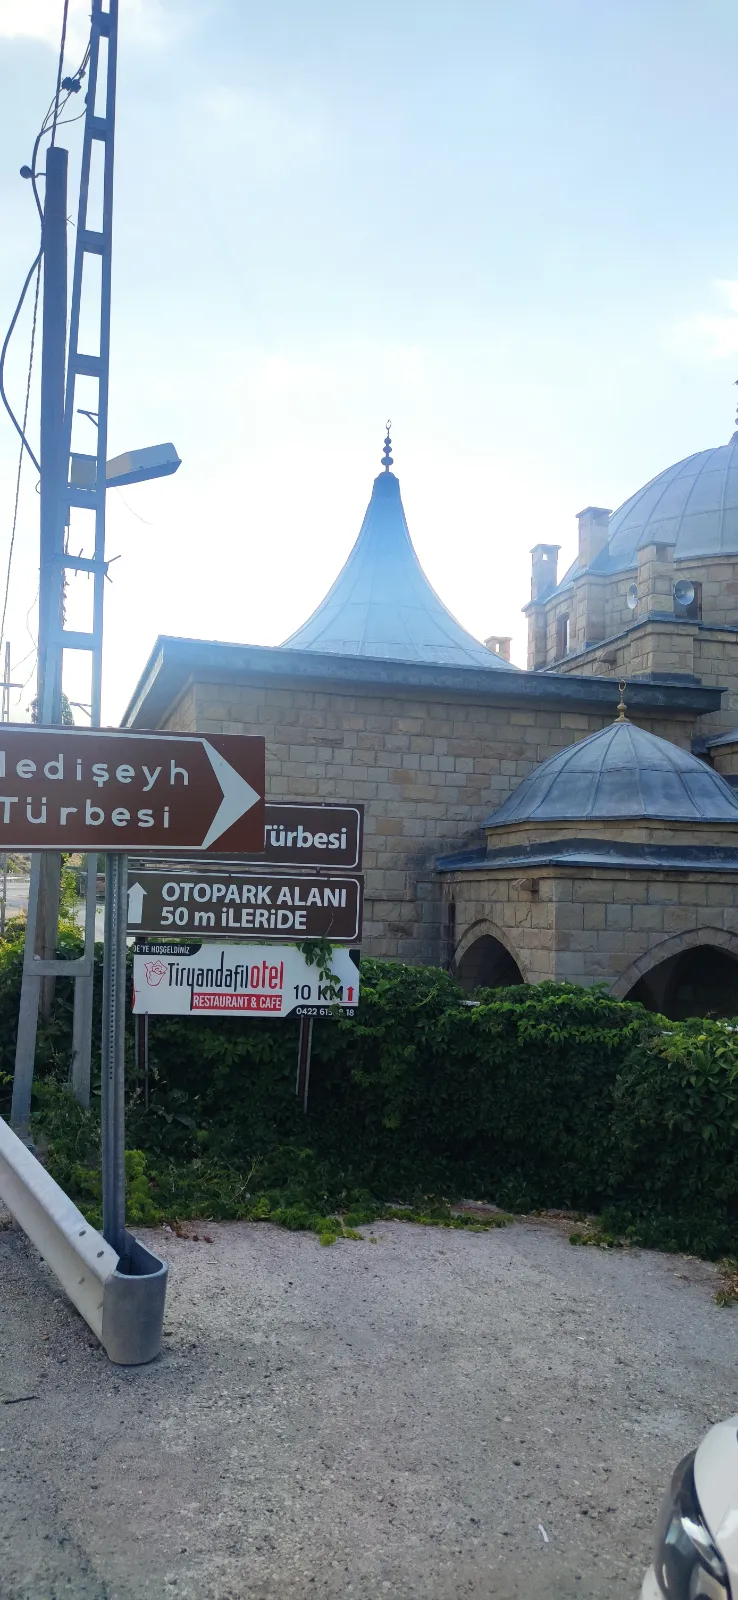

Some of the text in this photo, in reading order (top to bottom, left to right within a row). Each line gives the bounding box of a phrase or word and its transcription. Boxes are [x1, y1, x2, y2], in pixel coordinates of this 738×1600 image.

[0, 796, 170, 829] Türbesi
[161, 881, 347, 907] OTOPARK ALANI
[160, 906, 189, 926] 50
[194, 911, 215, 927] m
[293, 984, 311, 1000] 10
[193, 994, 282, 1009] RESTAURANT & CAFE
[296, 1007, 318, 1015] 0422
[346, 1008, 355, 1017] 18
